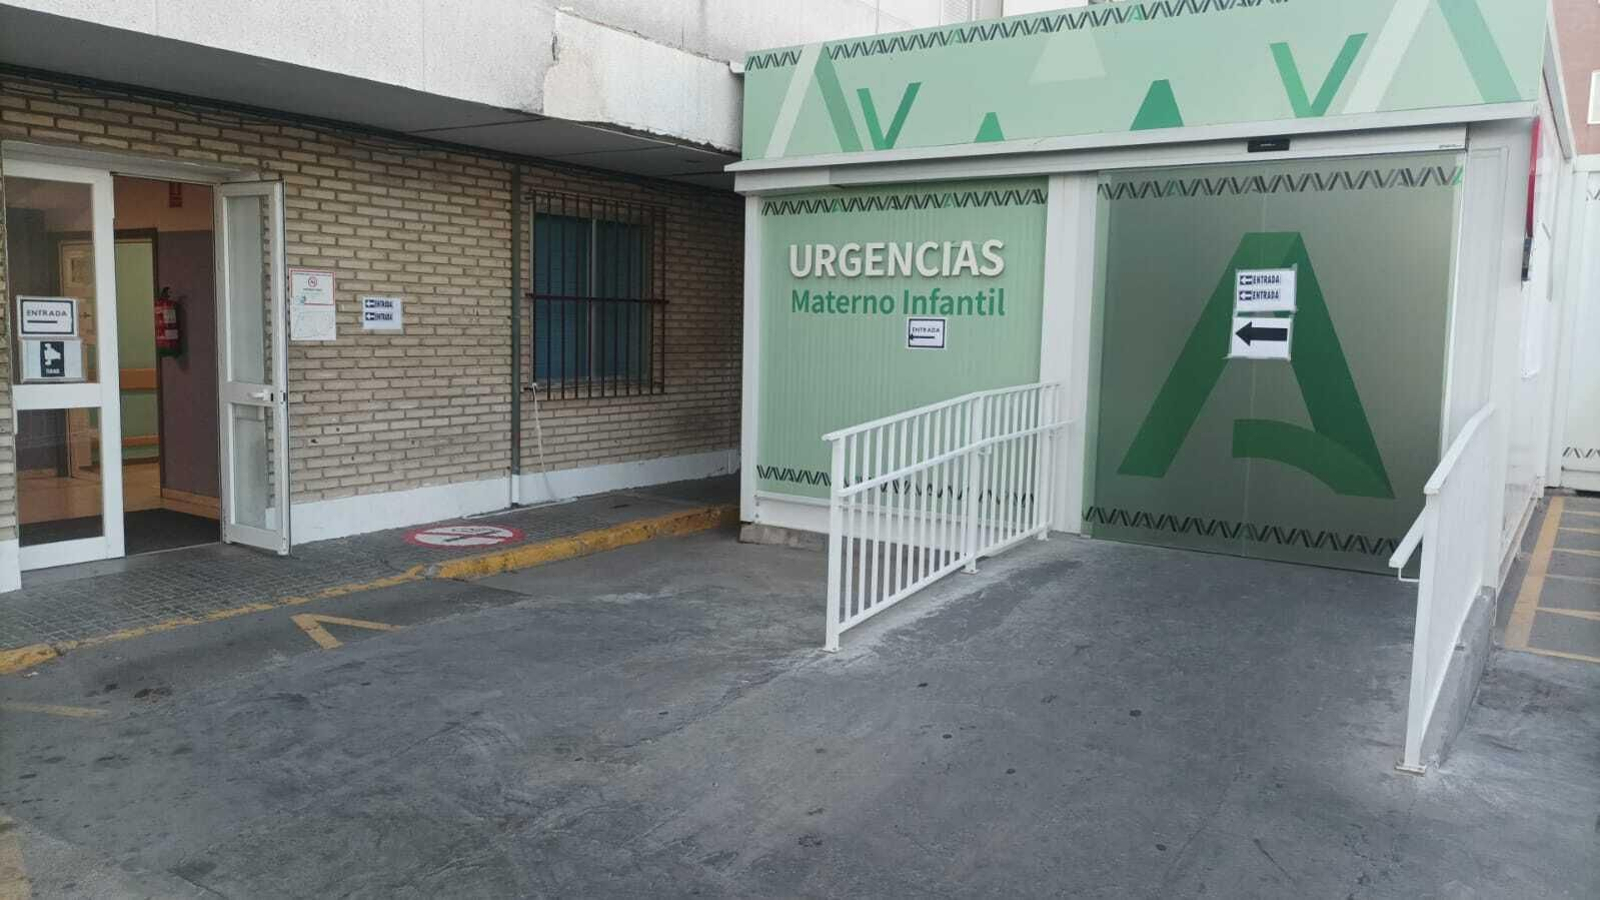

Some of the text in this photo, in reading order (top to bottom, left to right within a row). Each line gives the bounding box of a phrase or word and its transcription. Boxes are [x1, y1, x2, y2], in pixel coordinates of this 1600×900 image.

[789, 239, 1005, 278] URGENCIAS
[1253, 275, 1280, 285] ENTRADA
[1252, 290, 1279, 300] ENTRADA
[791, 287, 1006, 317] Materno Infantil
[26, 309, 68, 317] ENTRADA
